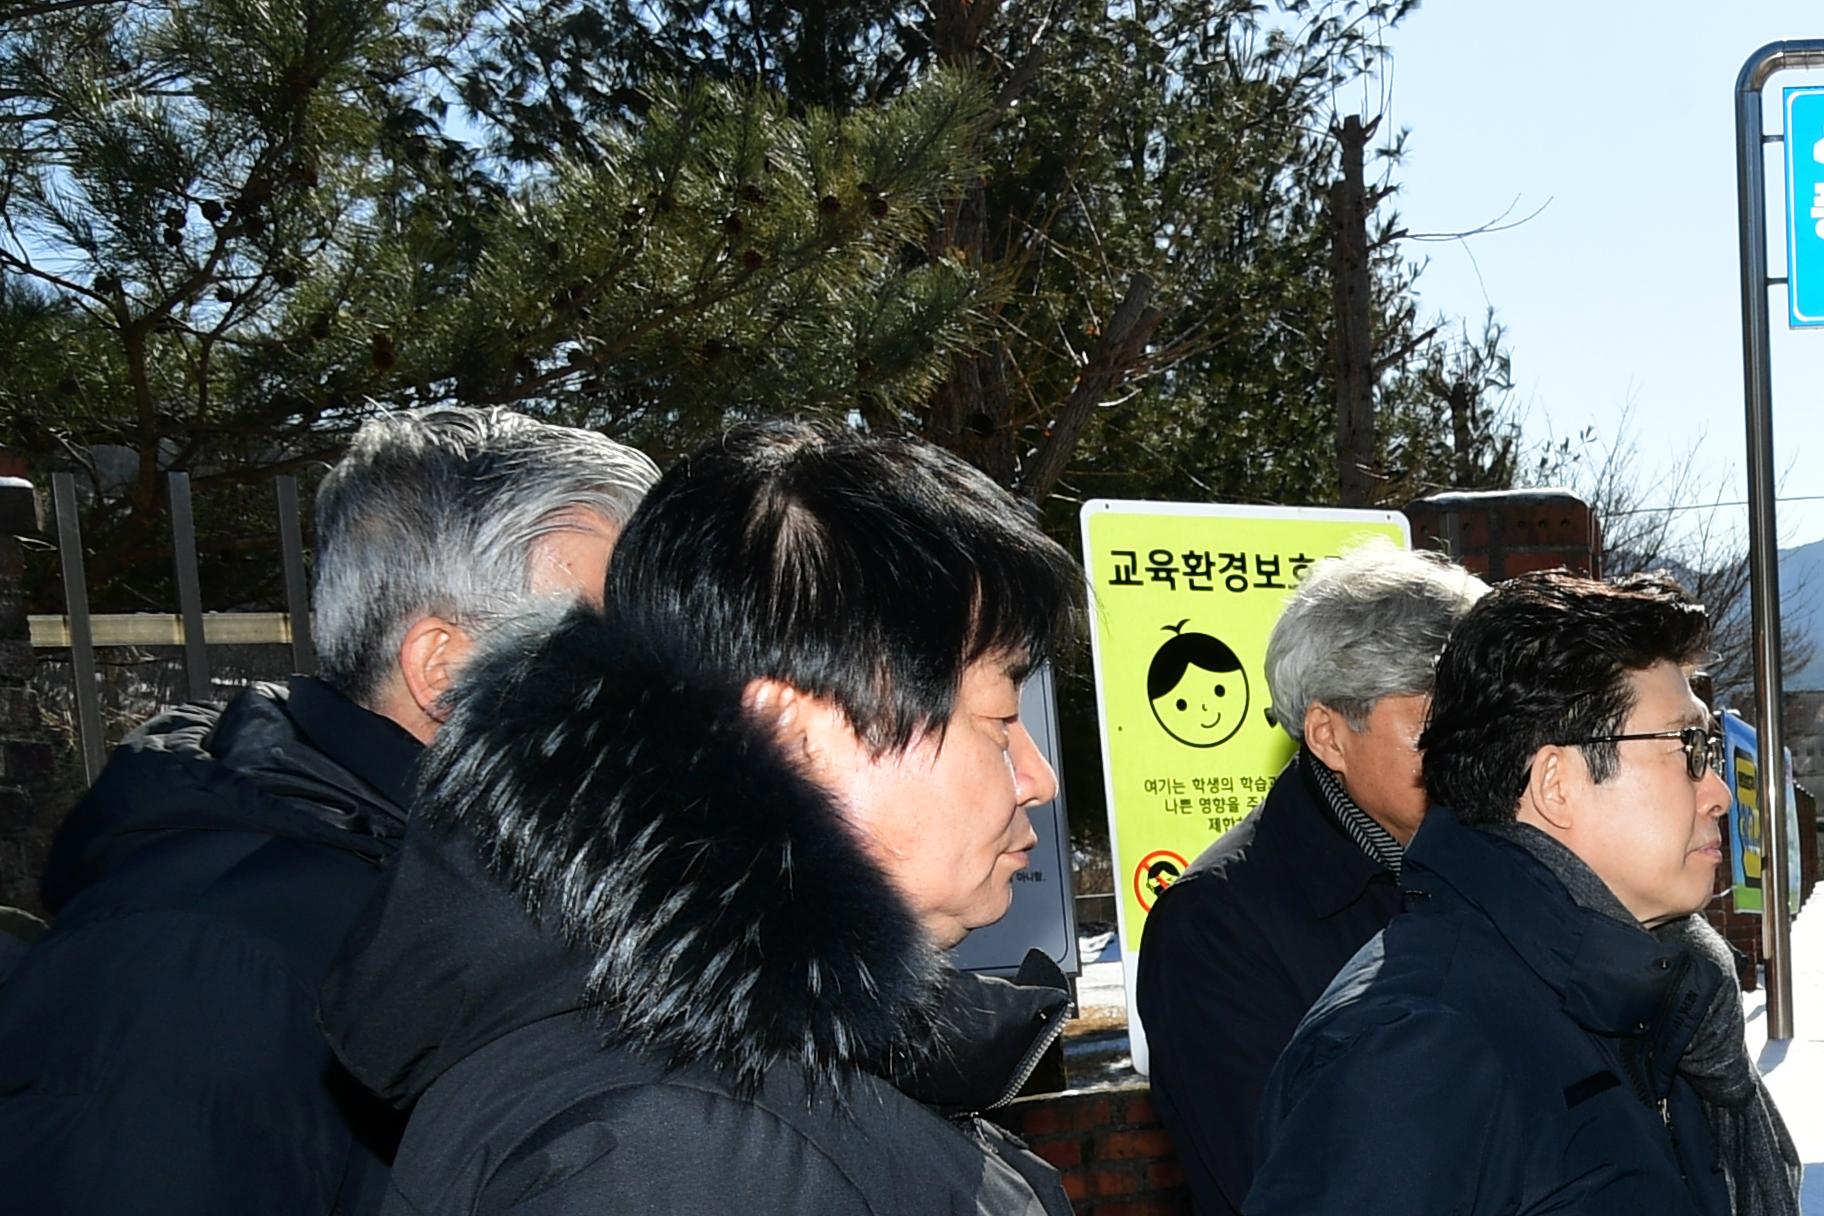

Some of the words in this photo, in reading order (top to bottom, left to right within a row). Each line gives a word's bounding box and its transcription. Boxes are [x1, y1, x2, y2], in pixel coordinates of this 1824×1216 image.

[1108, 549, 1342, 593] 교육환경보호
[1144, 778, 1186, 795] 여기는
[1192, 777, 1234, 794] 학생의
[1199, 796, 1240, 814] 영향을
[1208, 817, 1243, 833] 제한
